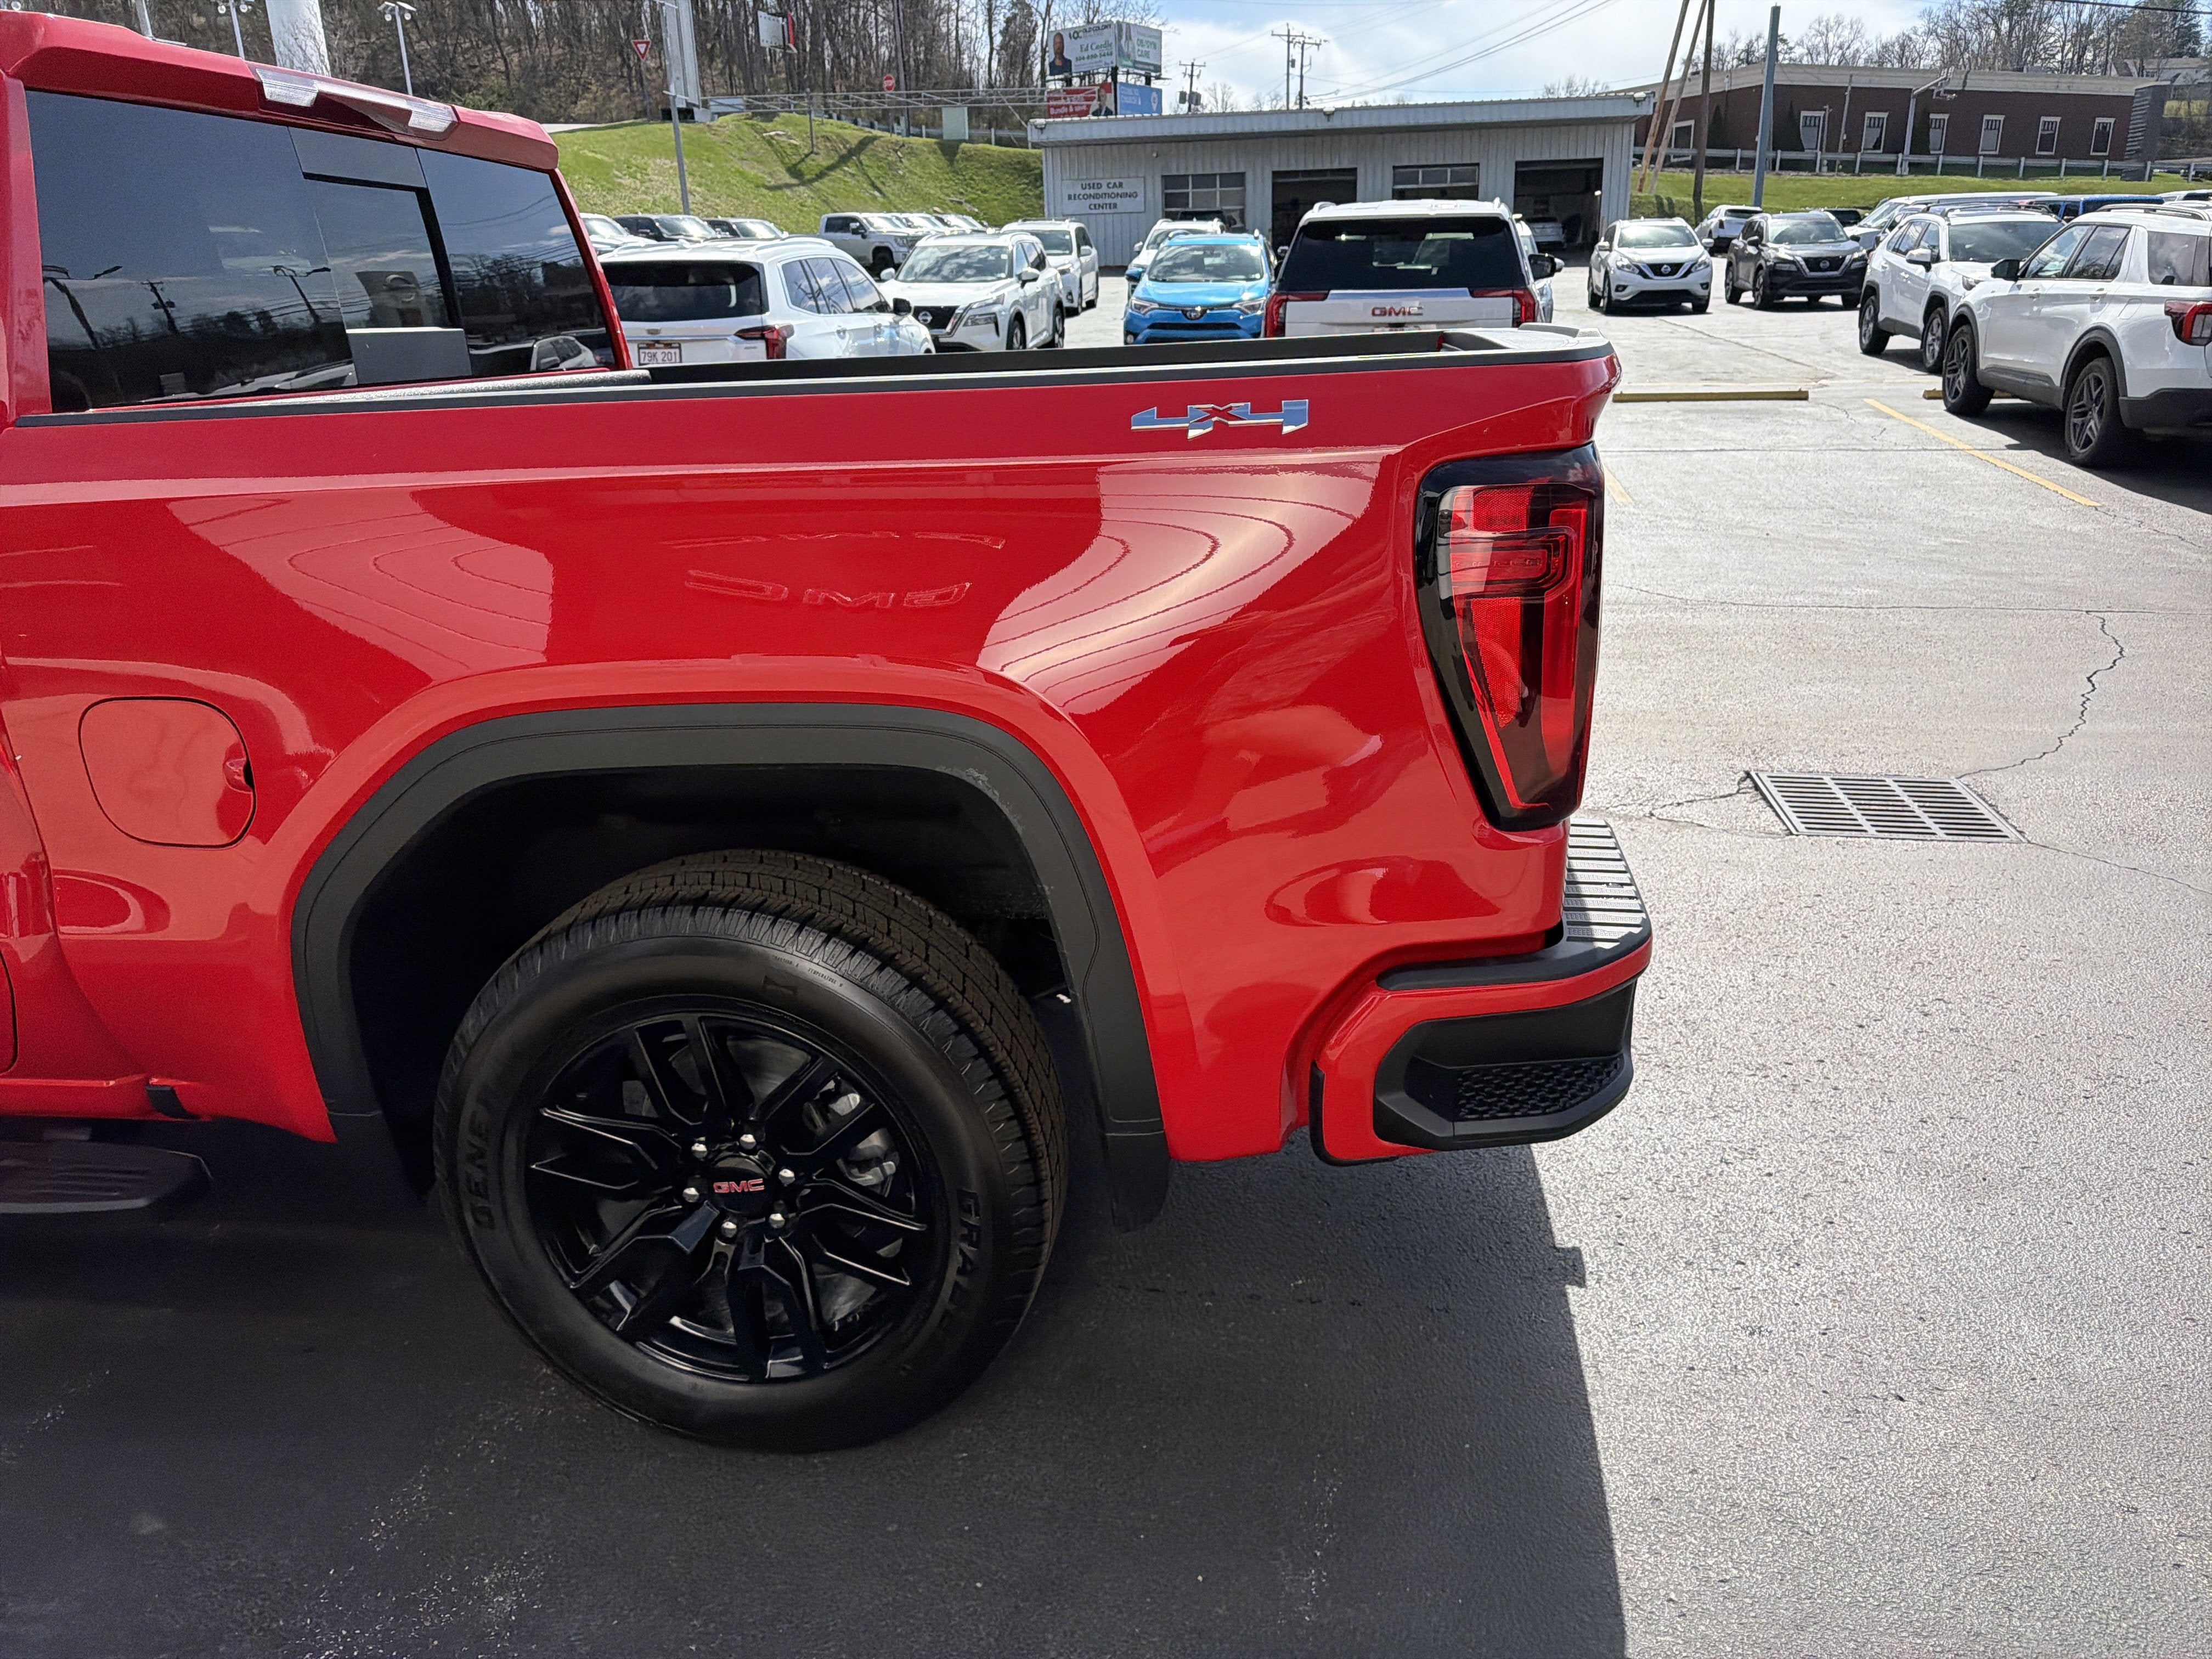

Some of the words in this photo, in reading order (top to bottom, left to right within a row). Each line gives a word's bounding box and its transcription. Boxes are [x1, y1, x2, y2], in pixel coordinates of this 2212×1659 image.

[1080, 43, 1089, 53] Ed
[1107, 181, 1124, 189] CAR
[1067, 191, 1138, 201] RECONDITIONING
[1088, 202, 1118, 211] CENTER
[1371, 306, 1424, 317] GMC
[641, 351, 659, 362] 79K
[661, 351, 678, 363] 201
[808, 968, 837, 985] TEMPERATURE
[713, 1178, 765, 1194] GMC
